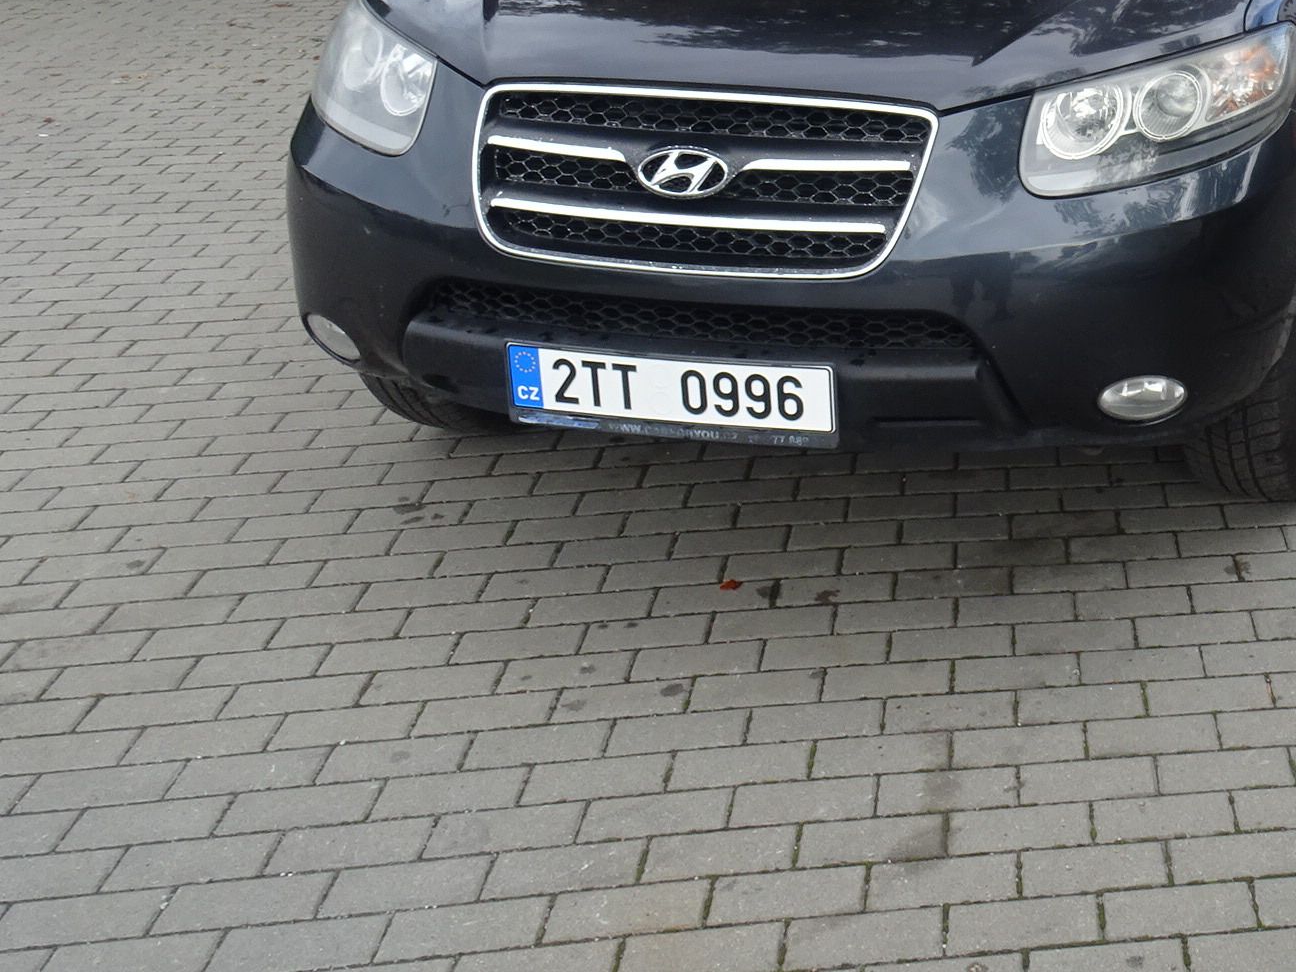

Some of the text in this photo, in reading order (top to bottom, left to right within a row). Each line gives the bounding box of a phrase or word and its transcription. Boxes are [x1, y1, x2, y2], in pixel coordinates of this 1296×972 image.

[517, 385, 540, 401] CZ
[551, 357, 804, 421] 2TT 0996
